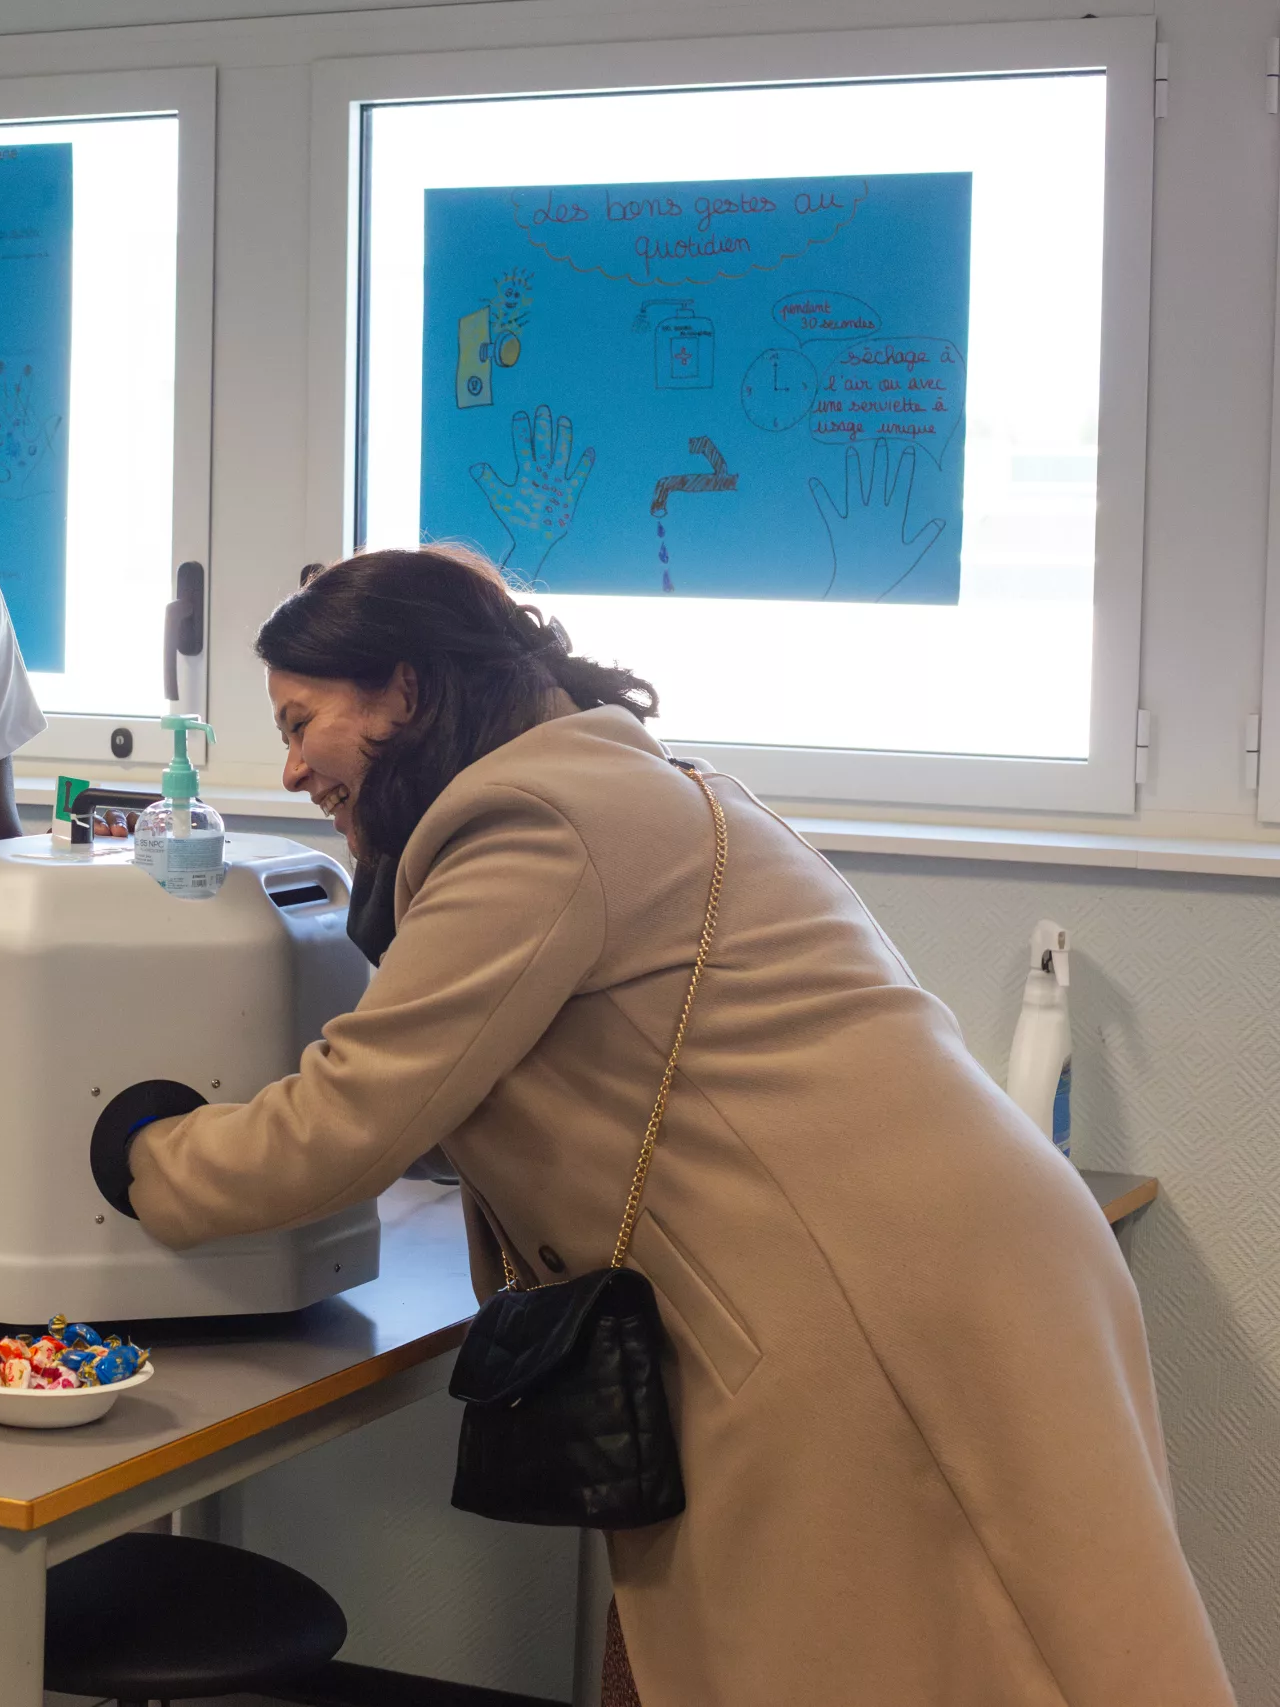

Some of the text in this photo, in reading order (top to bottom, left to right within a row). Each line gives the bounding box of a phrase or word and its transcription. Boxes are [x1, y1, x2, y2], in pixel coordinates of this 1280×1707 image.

[532, 189, 845, 233] Les bons gestes au
[635, 233, 752, 277] quotidien
[800, 316, 876, 330] 30 secondes
[840, 345, 956, 373] séchage à
[823, 374, 948, 392] l'air ou avec
[812, 396, 949, 414] une serviette à
[813, 419, 937, 441] usage unique
[148, 839, 165, 849] NPC
